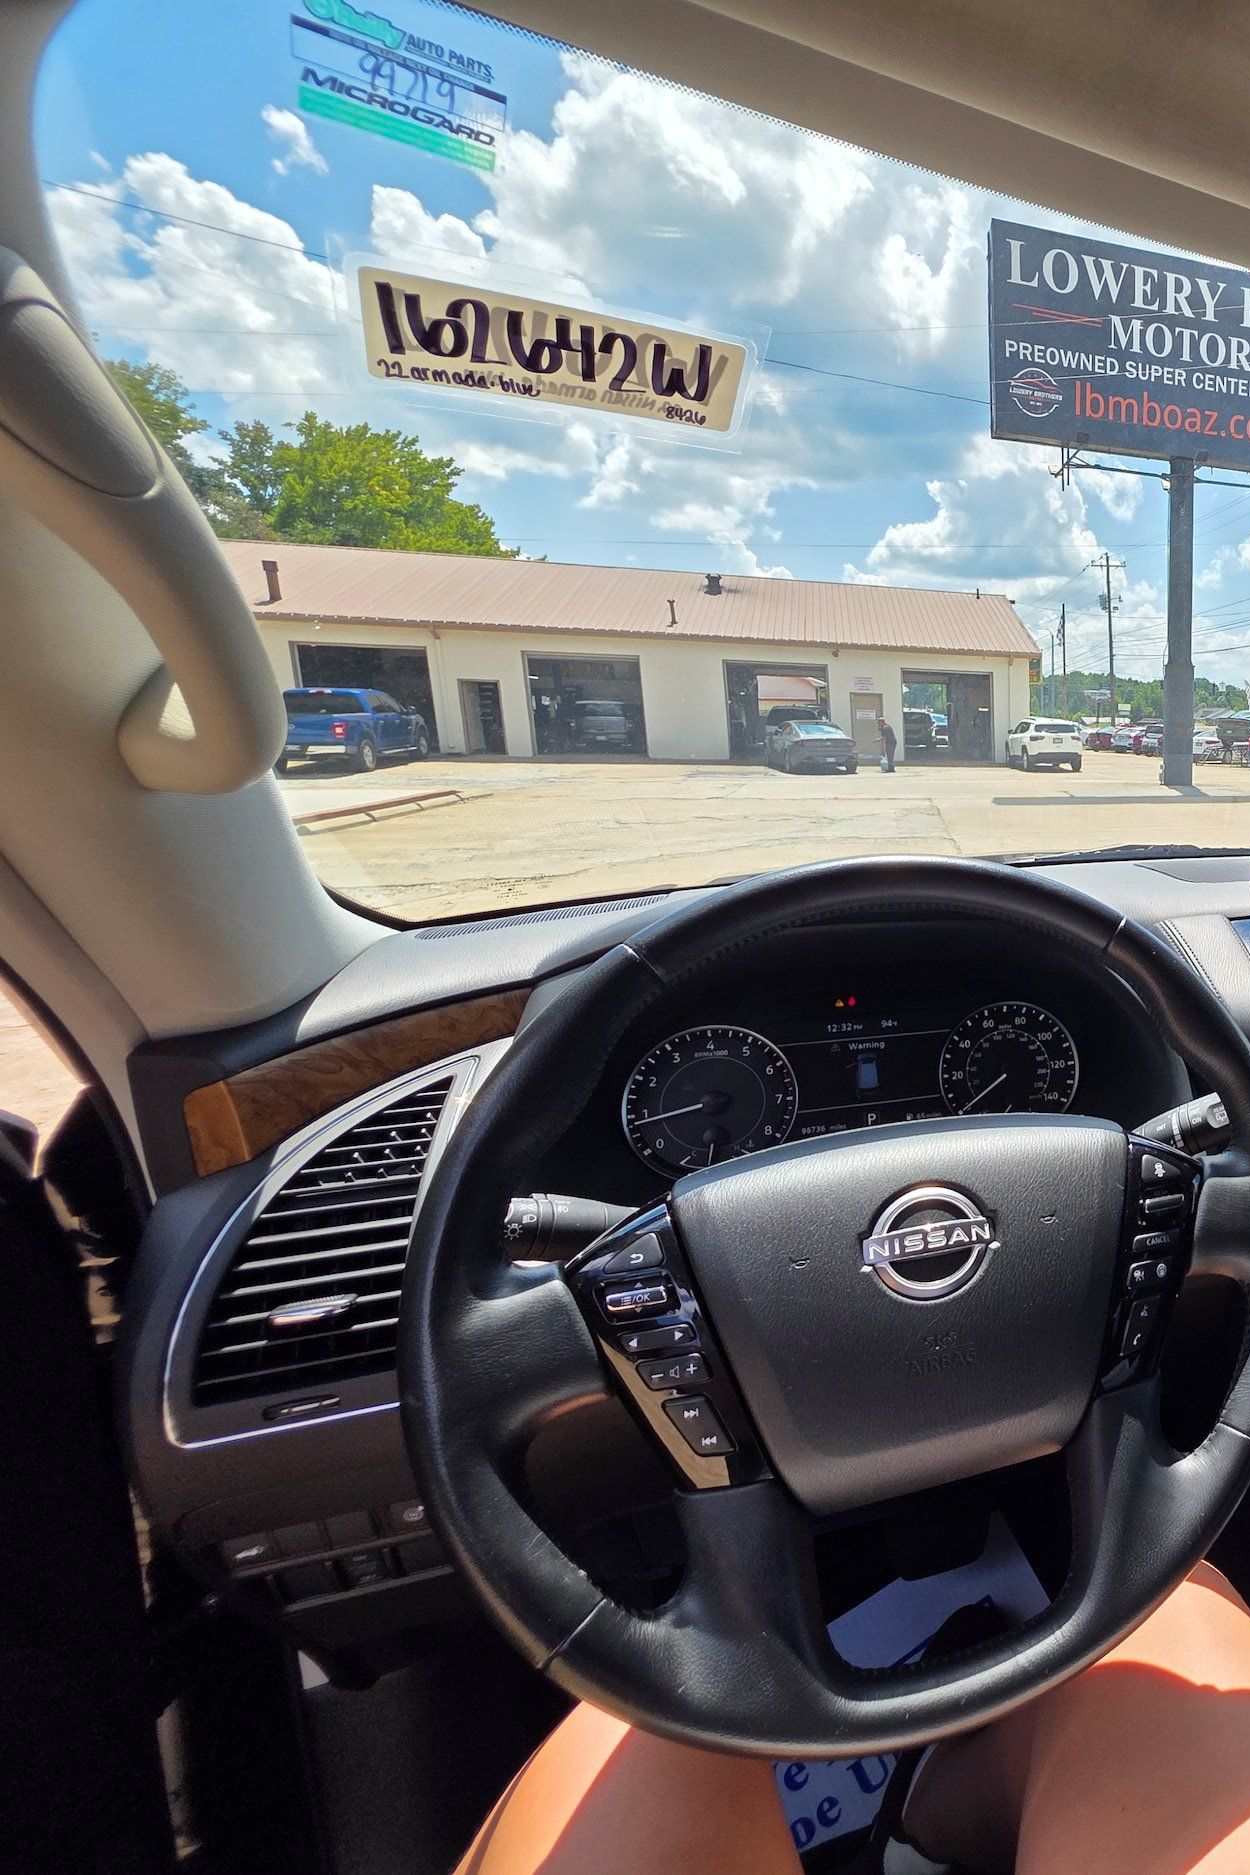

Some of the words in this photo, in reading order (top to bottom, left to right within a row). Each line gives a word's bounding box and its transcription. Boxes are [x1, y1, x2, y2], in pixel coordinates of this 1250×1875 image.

[406, 34, 444, 58] AUTO
[1006, 237, 1227, 322] LOWERY
[374, 281, 713, 402] 162642W
[1004, 339, 1120, 376] PREOWNED
[1125, 360, 1188, 387] SUPER
[377, 358, 410, 379] 22
[500, 374, 541, 398] blue
[983, 1020, 994, 1028] 60
[1014, 1017, 1026, 1025] 80
[826, 1022, 853, 1032] 12:32
[1038, 1032, 1052, 1041] 100
[706, 1040, 715, 1050] 4
[848, 1042, 886, 1050] Warning
[959, 1040, 970, 1048] 40
[742, 1046, 750, 1056] 5
[672, 1053, 680, 1064] 3
[1050, 1060, 1066, 1069] 120
[766, 1065, 774, 1075] 6
[952, 1071, 964, 1080] 20
[650, 1076, 657, 1087] 2
[776, 1094, 783, 1104] 7
[1044, 1092, 1058, 1100] 140
[642, 1109, 648, 1119] 1
[868, 1113, 876, 1126] P
[764, 1125, 772, 1136] 8
[801, 1126, 826, 1135] 96736
[656, 1138, 664, 1149] 0
[868, 1223, 990, 1260] NISSAN
[1146, 1235, 1170, 1246] CANCEL
